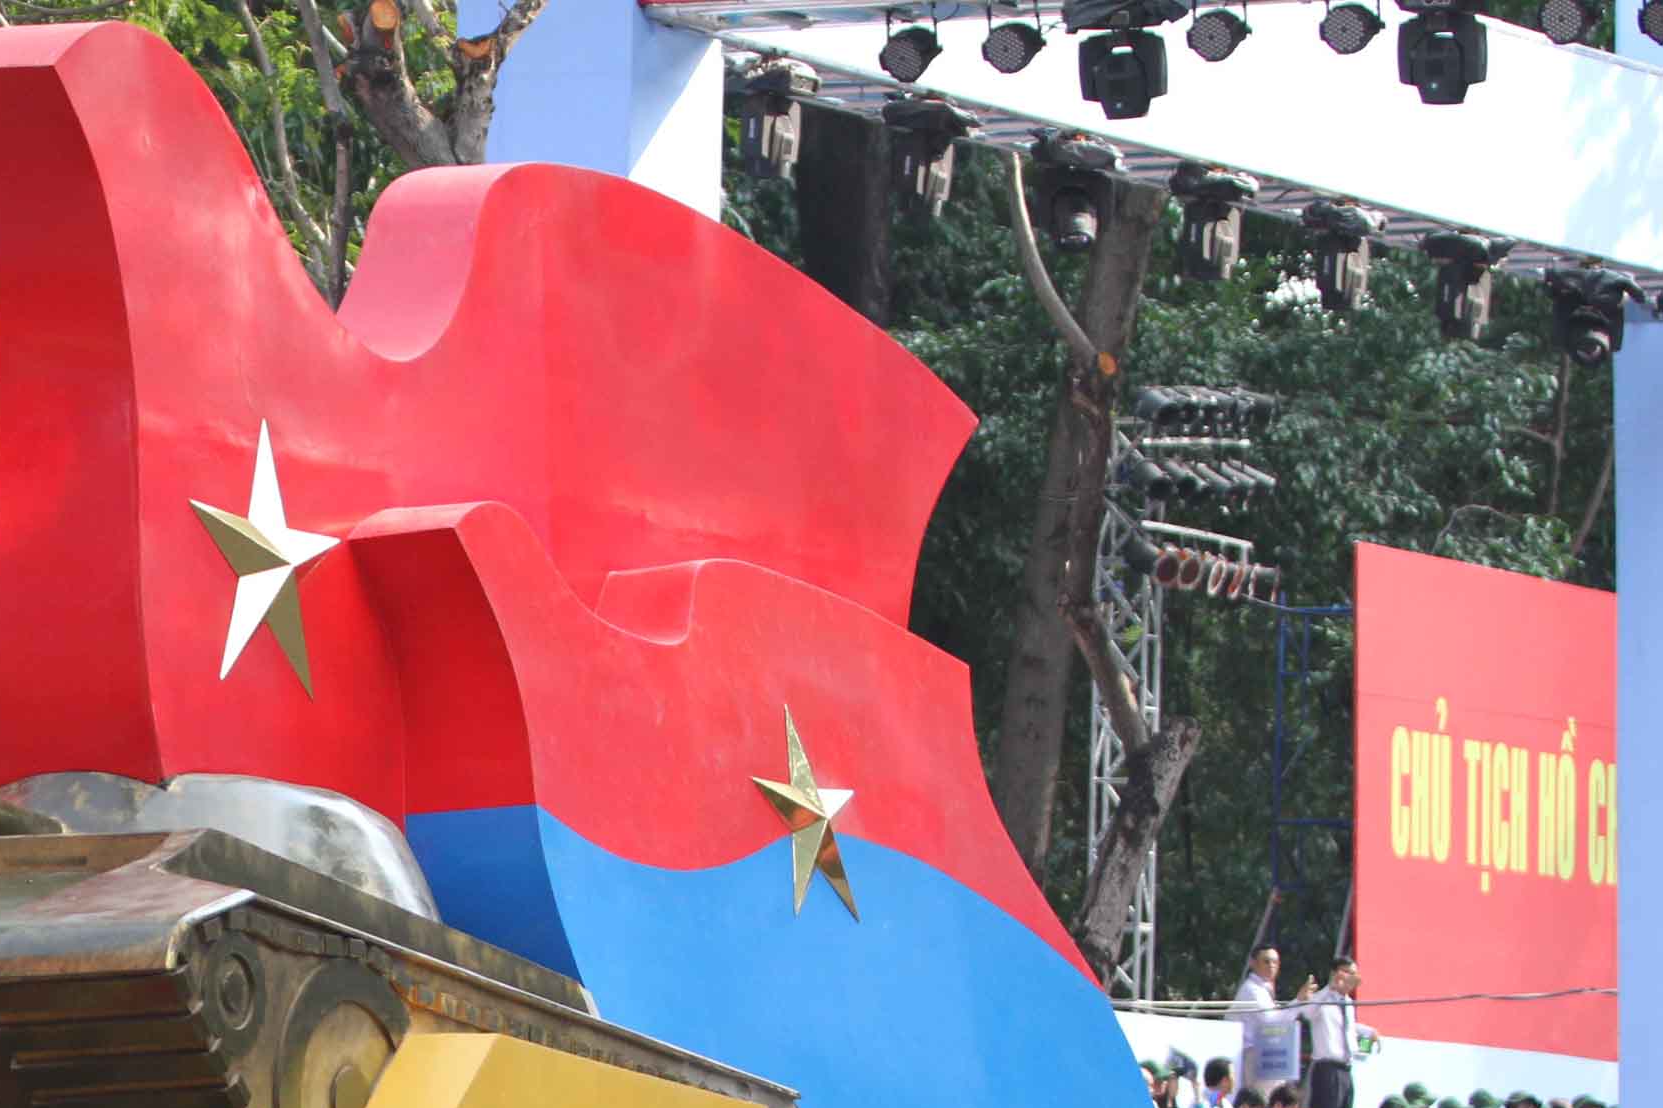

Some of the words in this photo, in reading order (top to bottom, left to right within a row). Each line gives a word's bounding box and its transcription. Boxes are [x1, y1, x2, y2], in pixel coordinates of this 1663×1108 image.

[1391, 697, 1452, 864] CHỦ
[1463, 738, 1529, 893] TỊCH
[1538, 716, 1576, 880] HỒ
